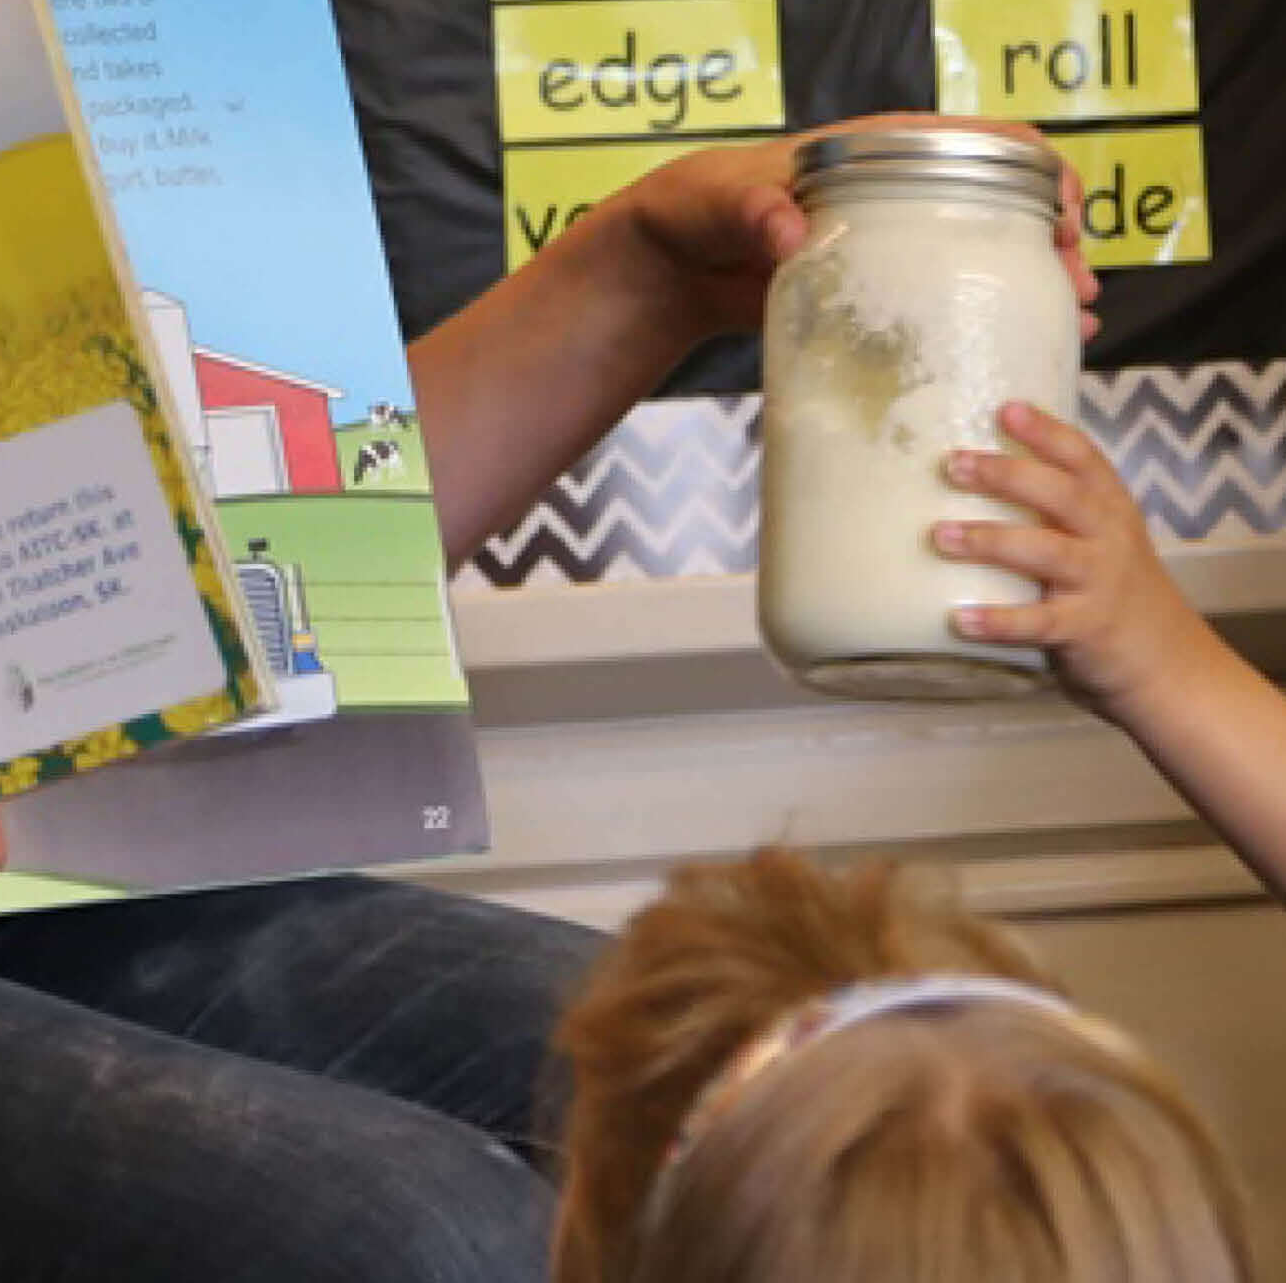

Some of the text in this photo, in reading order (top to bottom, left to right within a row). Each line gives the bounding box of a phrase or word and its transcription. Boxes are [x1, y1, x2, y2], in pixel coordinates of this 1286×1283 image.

[539, 30, 744, 131] edge
[1001, 12, 1140, 96] roll
[423, 805, 452, 830] 22
